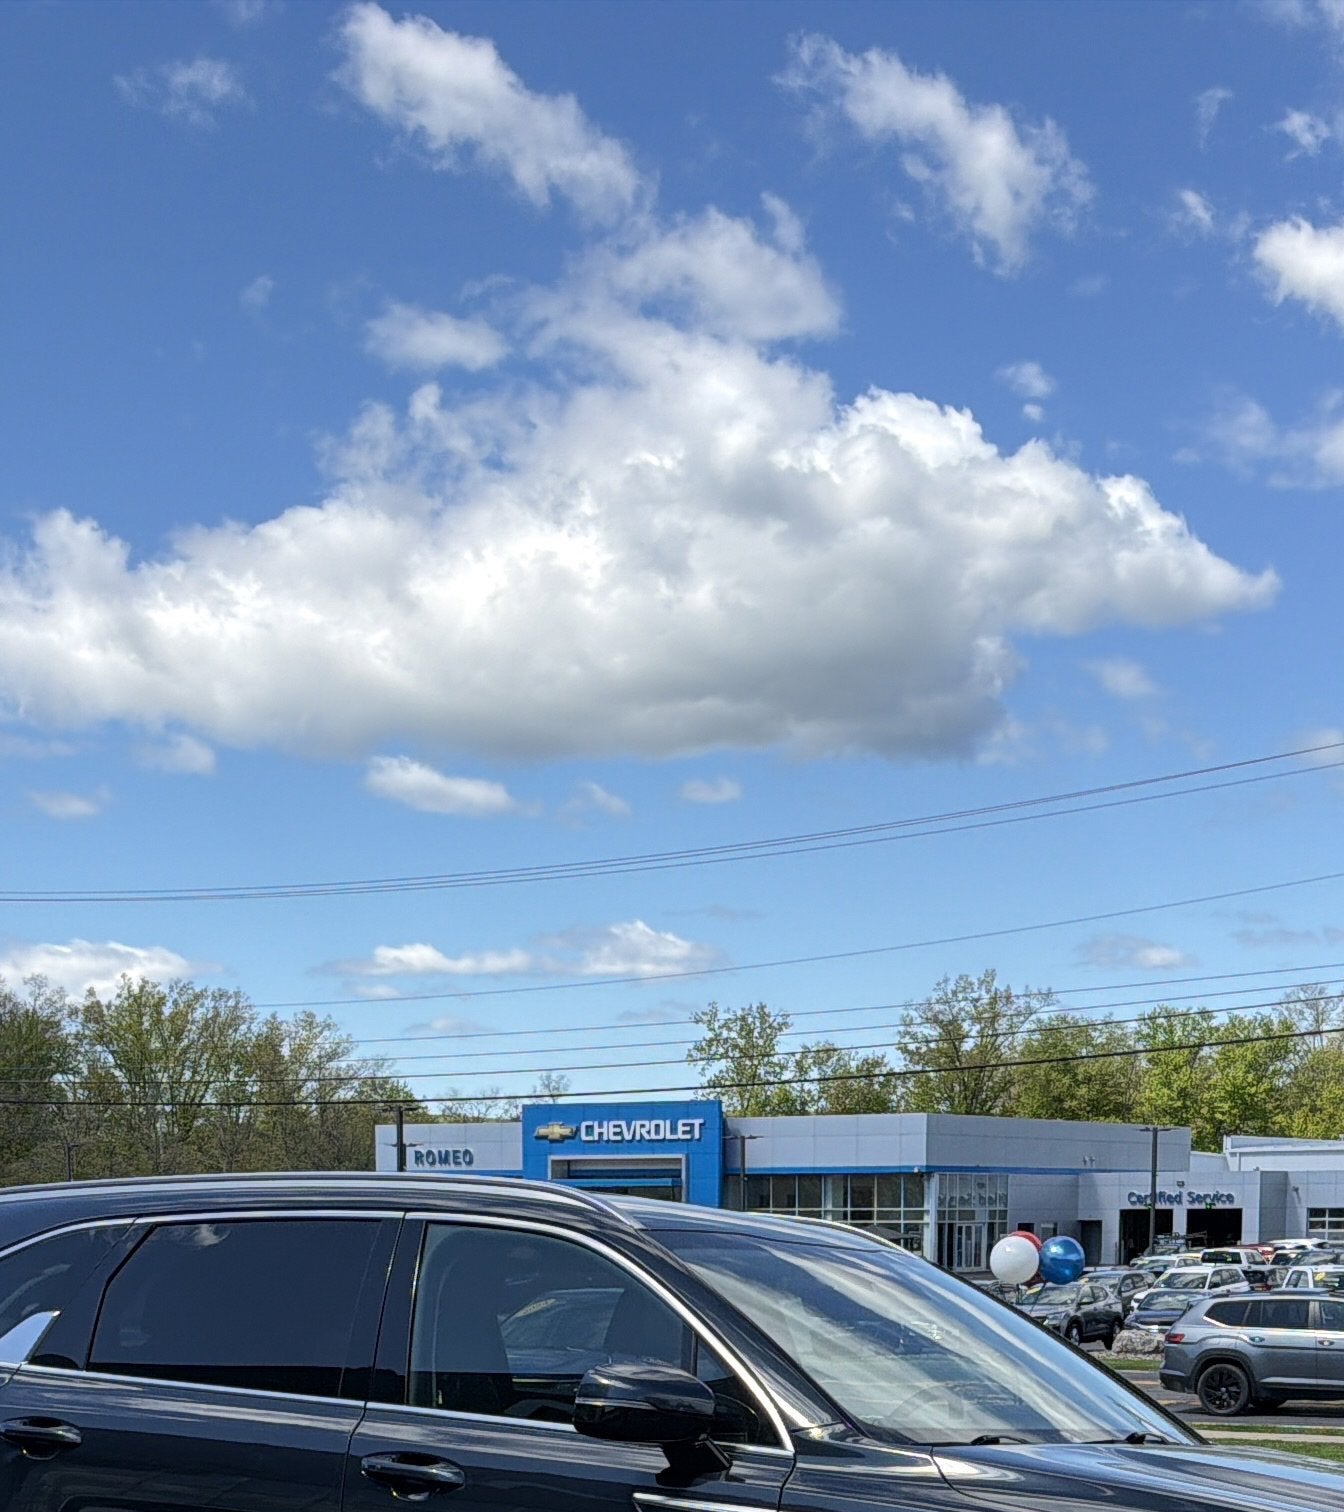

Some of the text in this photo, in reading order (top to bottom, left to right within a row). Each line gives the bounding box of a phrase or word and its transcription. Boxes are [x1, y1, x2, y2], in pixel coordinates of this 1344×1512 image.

[580, 1119, 704, 1142] CHEVROLET
[414, 1148, 474, 1167] ROMEO
[1187, 1190, 1235, 1205] Service
